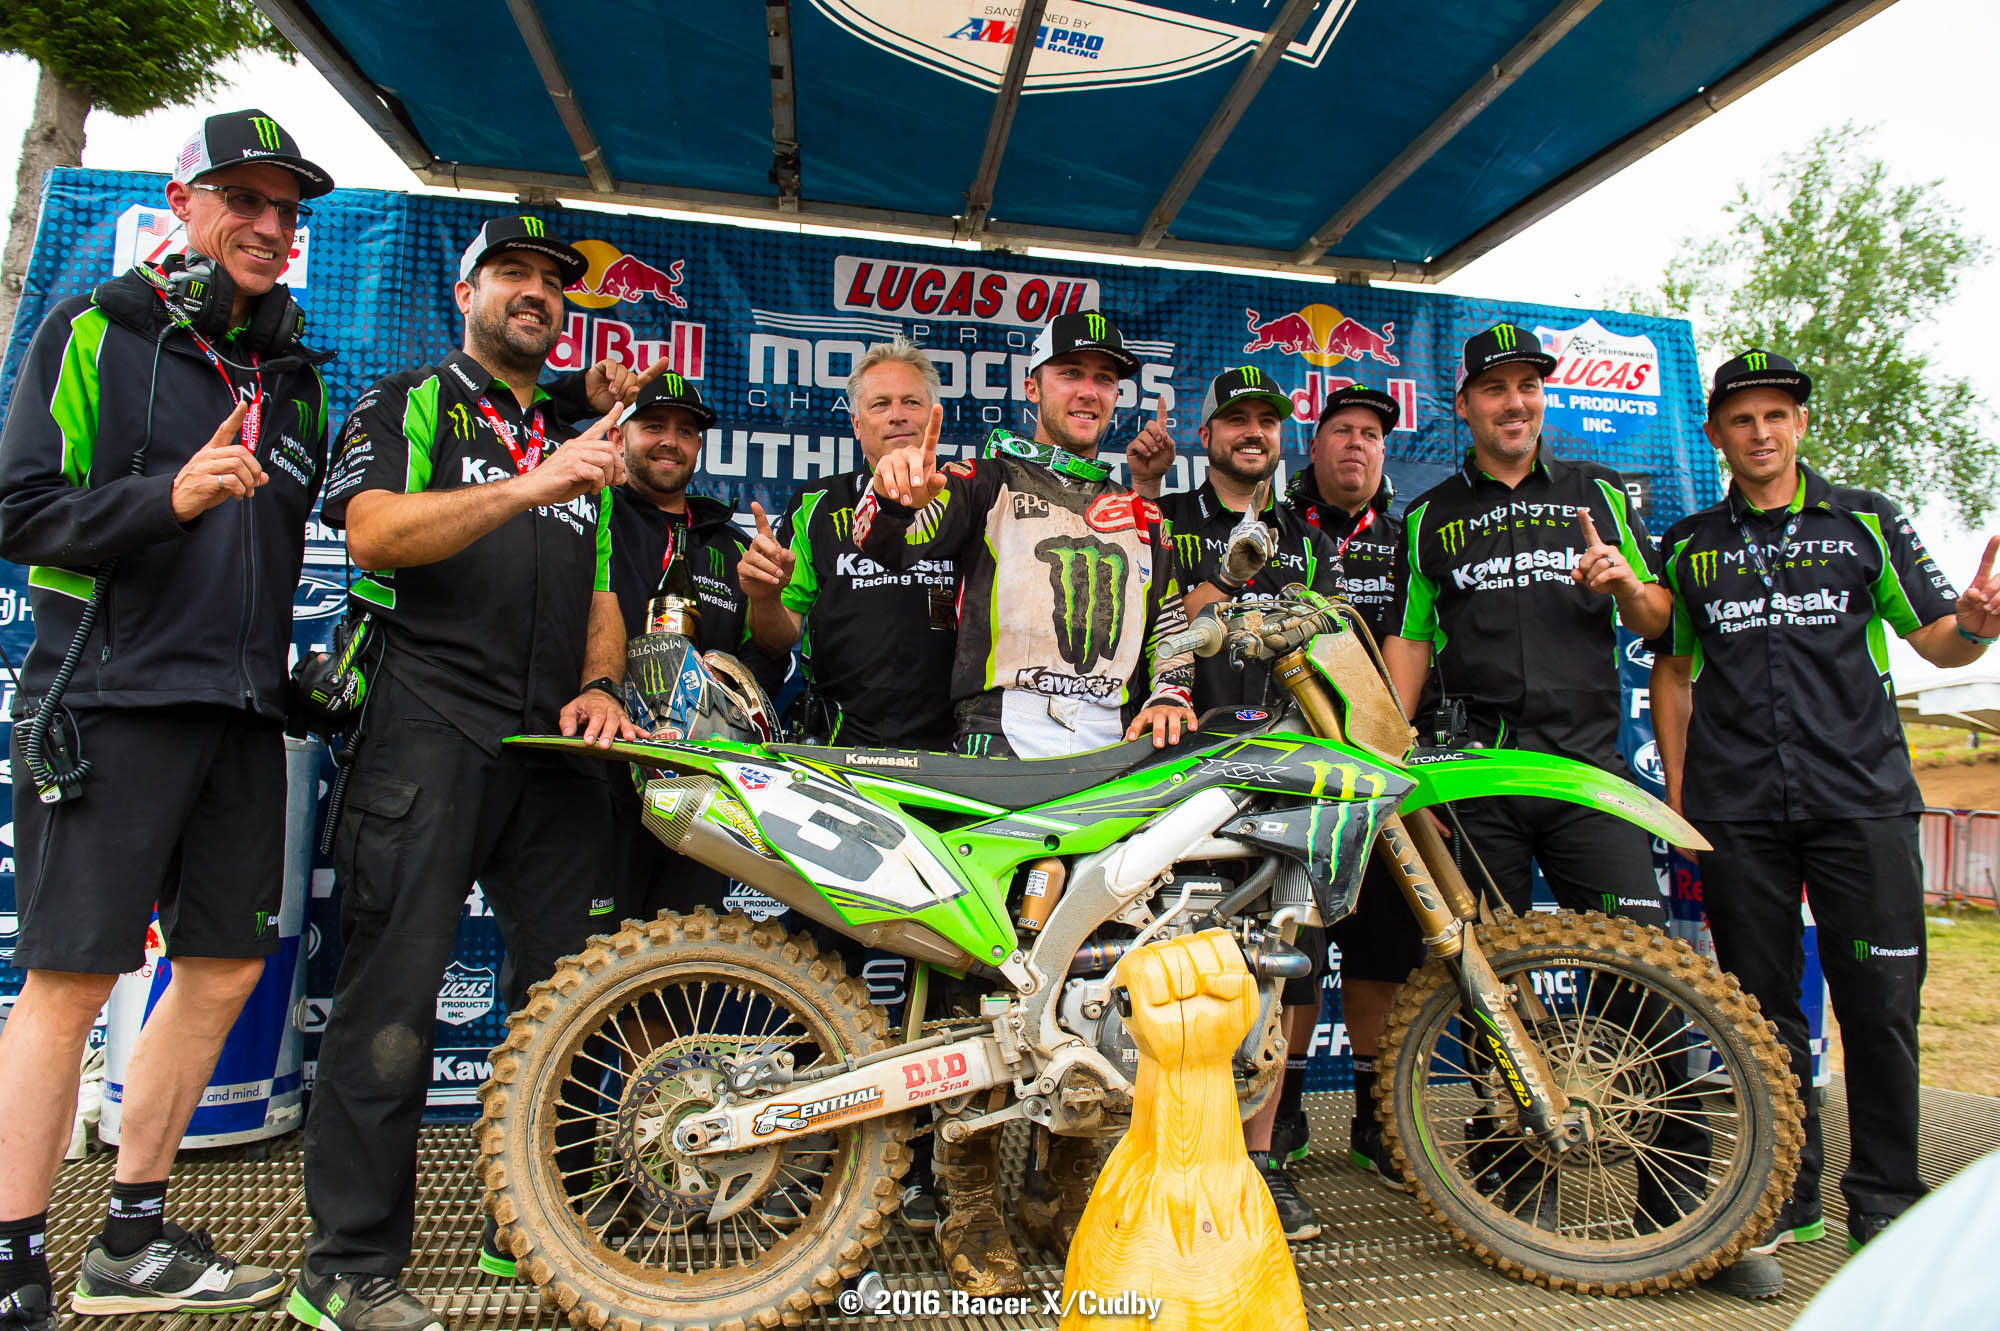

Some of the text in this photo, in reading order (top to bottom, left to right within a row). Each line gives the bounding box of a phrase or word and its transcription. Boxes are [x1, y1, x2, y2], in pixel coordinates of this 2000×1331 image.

[984, 5, 1092, 30] SANCNED BY
[1050, 27, 1104, 51] PRO
[1047, 43, 1099, 60] RACING
[505, 241, 580, 267] Kawasaki
[845, 262, 1087, 323] LUCAS OIL
[913, 325, 1025, 348] PRO
[592, 317, 706, 381] Bull
[448, 362, 480, 391] Kawasaki
[1546, 356, 1651, 391] LUCAS
[1726, 378, 1800, 390] Kawasaki
[1339, 398, 1394, 414] Kawasaki
[1569, 395, 1658, 416] PRODUCTS
[1583, 416, 1617, 434] INC.
[552, 506, 585, 536] Team
[1469, 500, 1594, 531] MONSTER
[1483, 519, 1571, 537] ENERGY
[1723, 540, 1858, 565] MNSTER
[1452, 547, 1583, 590] Kawasak
[1531, 569, 1576, 586] Team
[699, 592, 737, 613] wasaki
[1704, 588, 1850, 624] Kawasaki
[1784, 612, 1836, 626] Team
[845, 752, 919, 768] Kawasaki
[1411, 753, 1464, 764] TOMAC
[1198, 758, 1292, 783] KX
[757, 782, 906, 882] 3
[1677, 869, 1703, 902] Re
[726, 900, 742, 908] OIL
[1870, 946, 1919, 957] Kawasaki
[438, 982, 490, 997] UCAS
[207, 1085, 263, 1102] and mind.
[108, 1208, 161, 1219] Kawasaki
